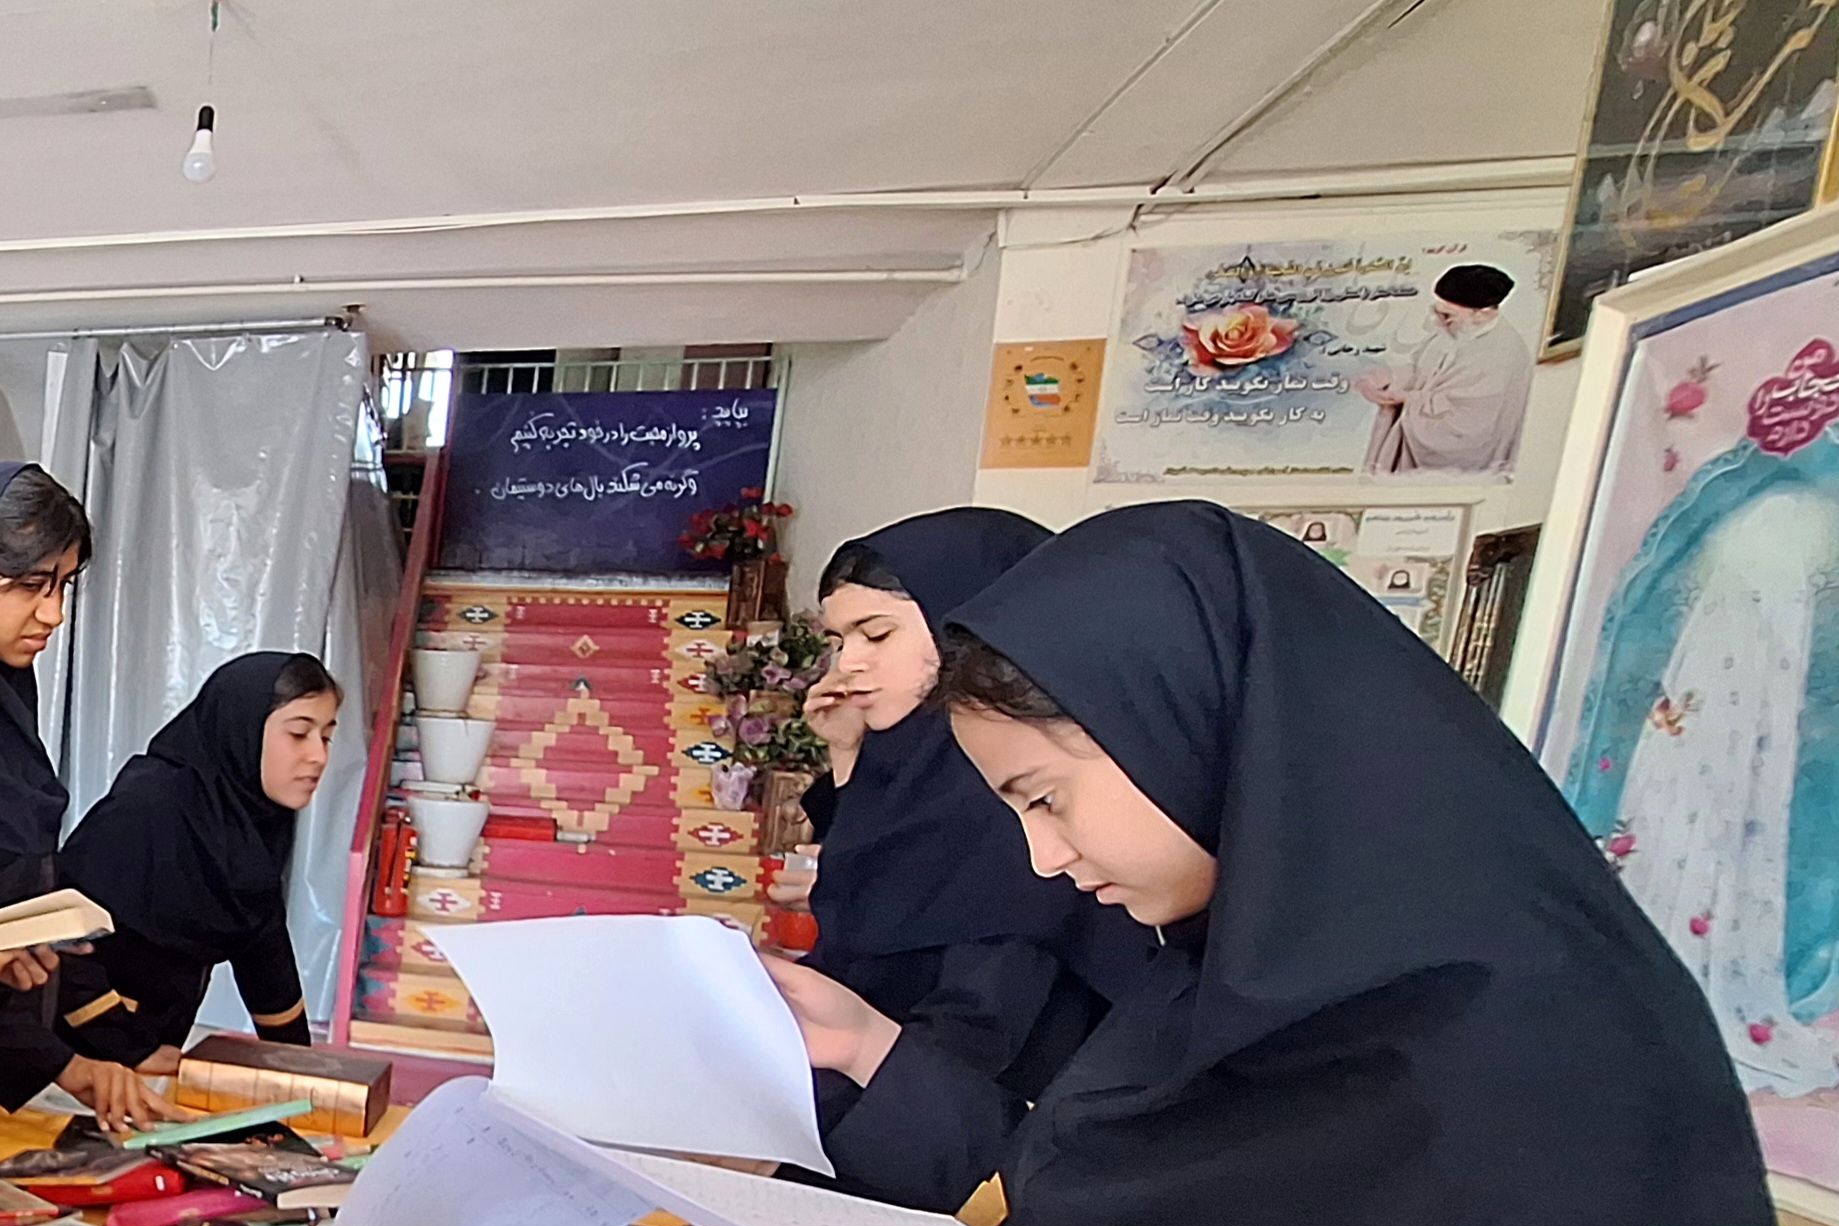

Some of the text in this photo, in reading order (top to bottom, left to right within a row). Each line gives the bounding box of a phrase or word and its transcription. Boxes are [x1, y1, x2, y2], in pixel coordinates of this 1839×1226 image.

[1144, 376, 1181, 393] است
[1184, 376, 1212, 396] کار
[1276, 374, 1308, 394] نماز
[1311, 374, 1350, 394] وقت
[1115, 409, 1151, 425] است
[1150, 408, 1182, 427] نماز
[1186, 409, 1221, 427] وقت
[1278, 407, 1307, 426] کار
[1309, 409, 1327, 422] به
[510, 411, 701, 453] پرواز محبت را در خود تجربه کنیم
[490, 475, 555, 501] دوستیمان
[665, 469, 700, 498] وگرنه
